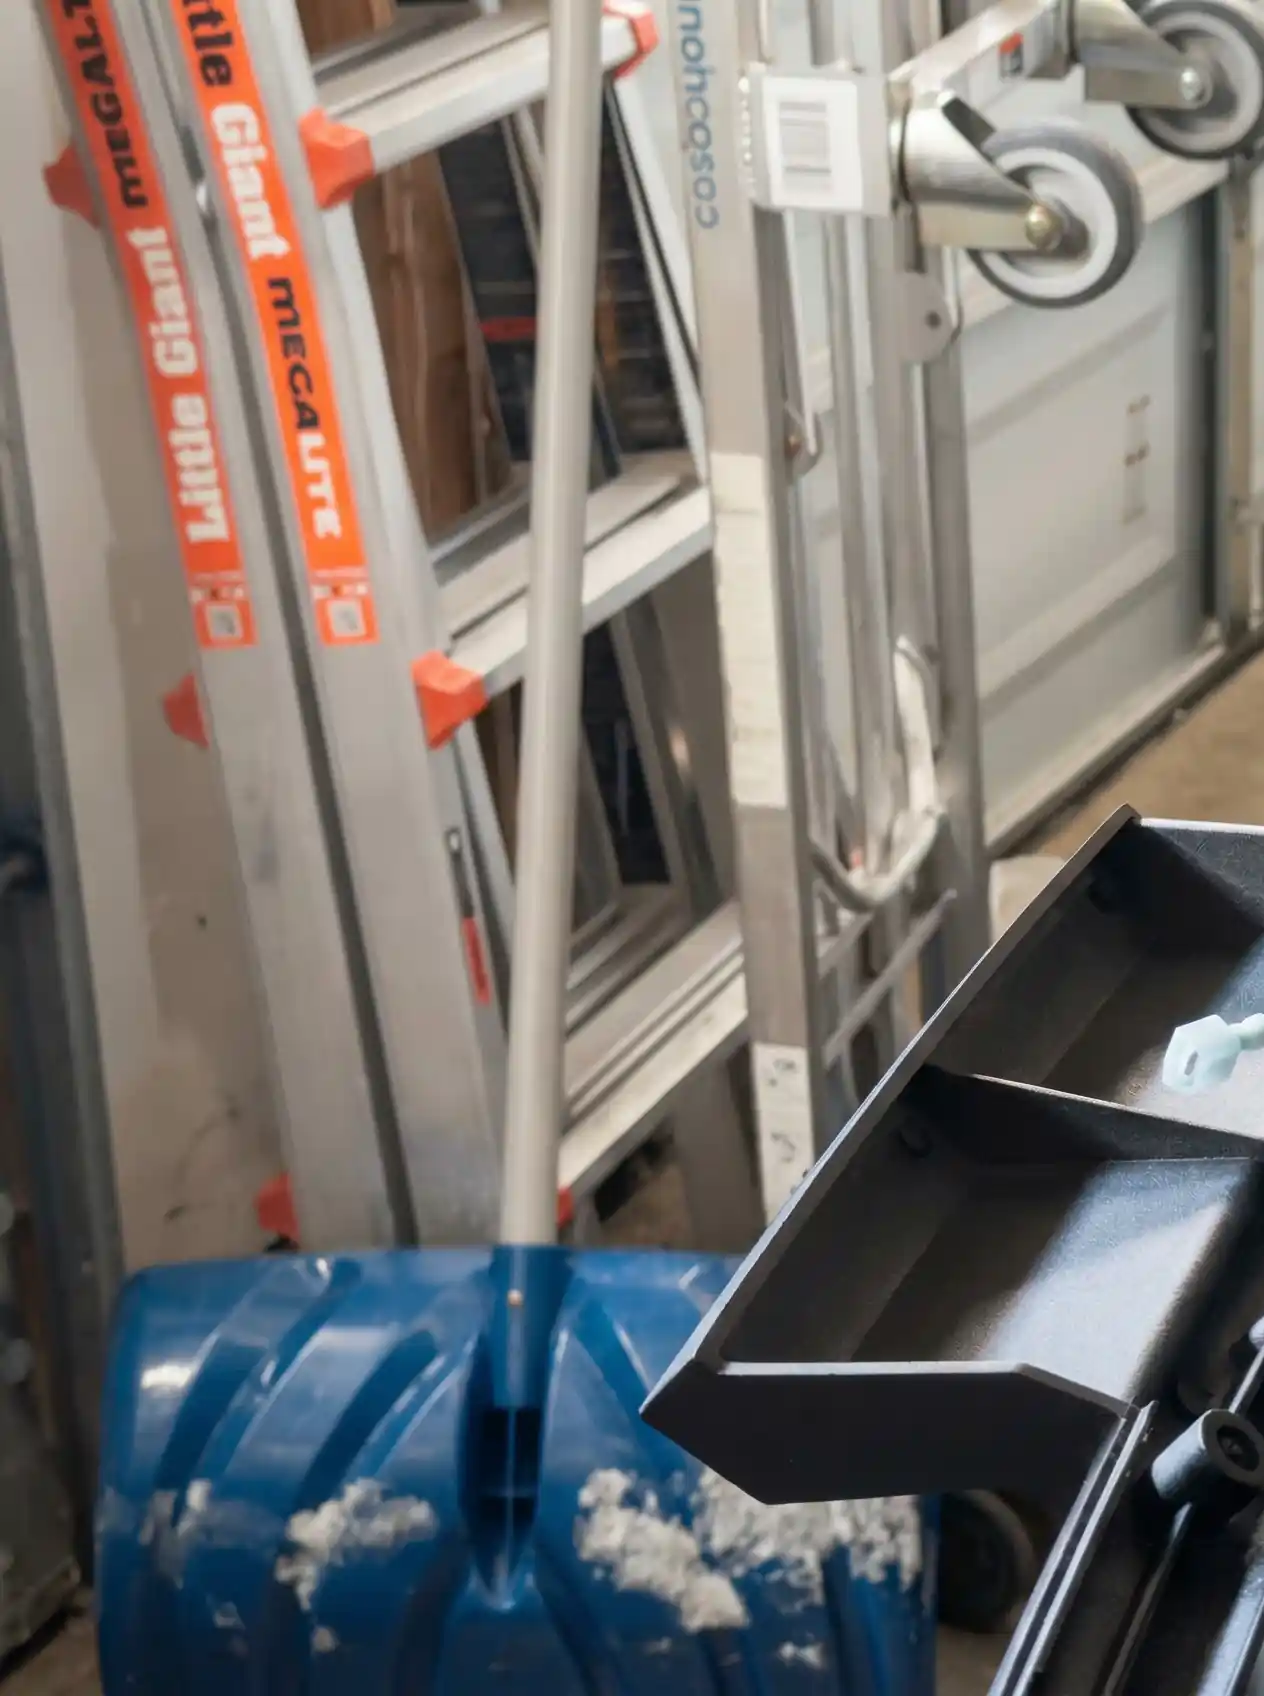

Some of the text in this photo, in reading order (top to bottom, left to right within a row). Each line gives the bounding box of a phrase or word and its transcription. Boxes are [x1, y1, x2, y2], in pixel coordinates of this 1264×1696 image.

[210, 103, 291, 260] Giant
[127, 226, 198, 379] Giant
[168, 393, 230, 543] Little
